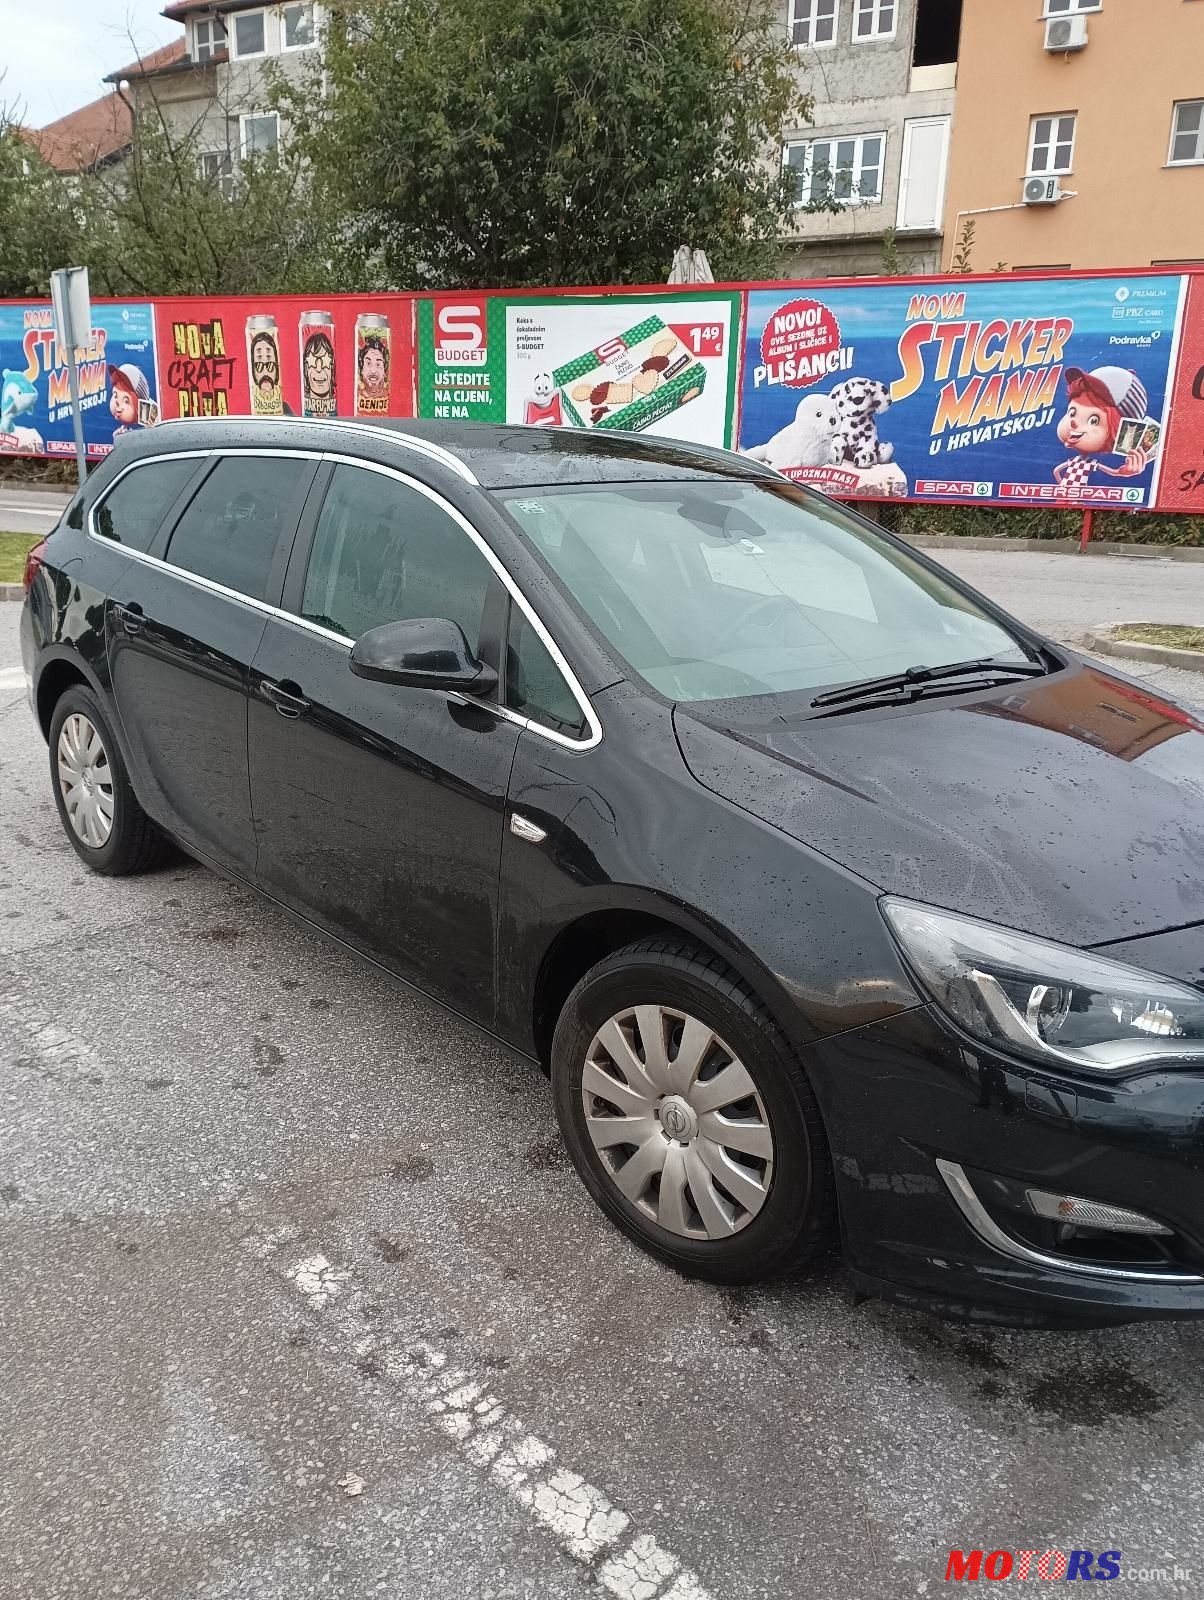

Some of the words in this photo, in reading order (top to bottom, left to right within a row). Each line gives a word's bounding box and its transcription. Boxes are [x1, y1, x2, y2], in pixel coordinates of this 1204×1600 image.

[905, 292, 967, 321] NOVA
[1125, 307, 1144, 317] PBZ
[774, 307, 823, 334] NOVO!
[172, 319, 225, 360] NOVA
[770, 335, 785, 346] OVE
[787, 328, 816, 342] SEZONE
[817, 325, 828, 336] UZ
[1109, 336, 1152, 345] Podravka
[437, 350, 485, 361] BUDGET
[768, 343, 793, 356] ALBUM
[799, 336, 827, 349] SLIČICE
[753, 347, 855, 388] PLIŠANCI!
[890, 317, 1074, 402] STICKER
[167, 357, 238, 390] CRAFT
[434, 370, 490, 386] UŠTEDITE
[178, 388, 228, 417] PIVA
[359, 398, 388, 410] GENIJE
[434, 390, 451, 402] NA
[453, 390, 493, 405] CIJENI,
[930, 364, 1064, 436] MANIA
[49, 410, 56, 423] U
[434, 406, 450, 418] NE
[452, 406, 469, 418] NA
[929, 439, 941, 456] U
[947, 408, 1056, 451] HRVATSKOJI
[922, 483, 973, 493] SPAR
[1011, 485, 1122, 499] INTERSPAR
